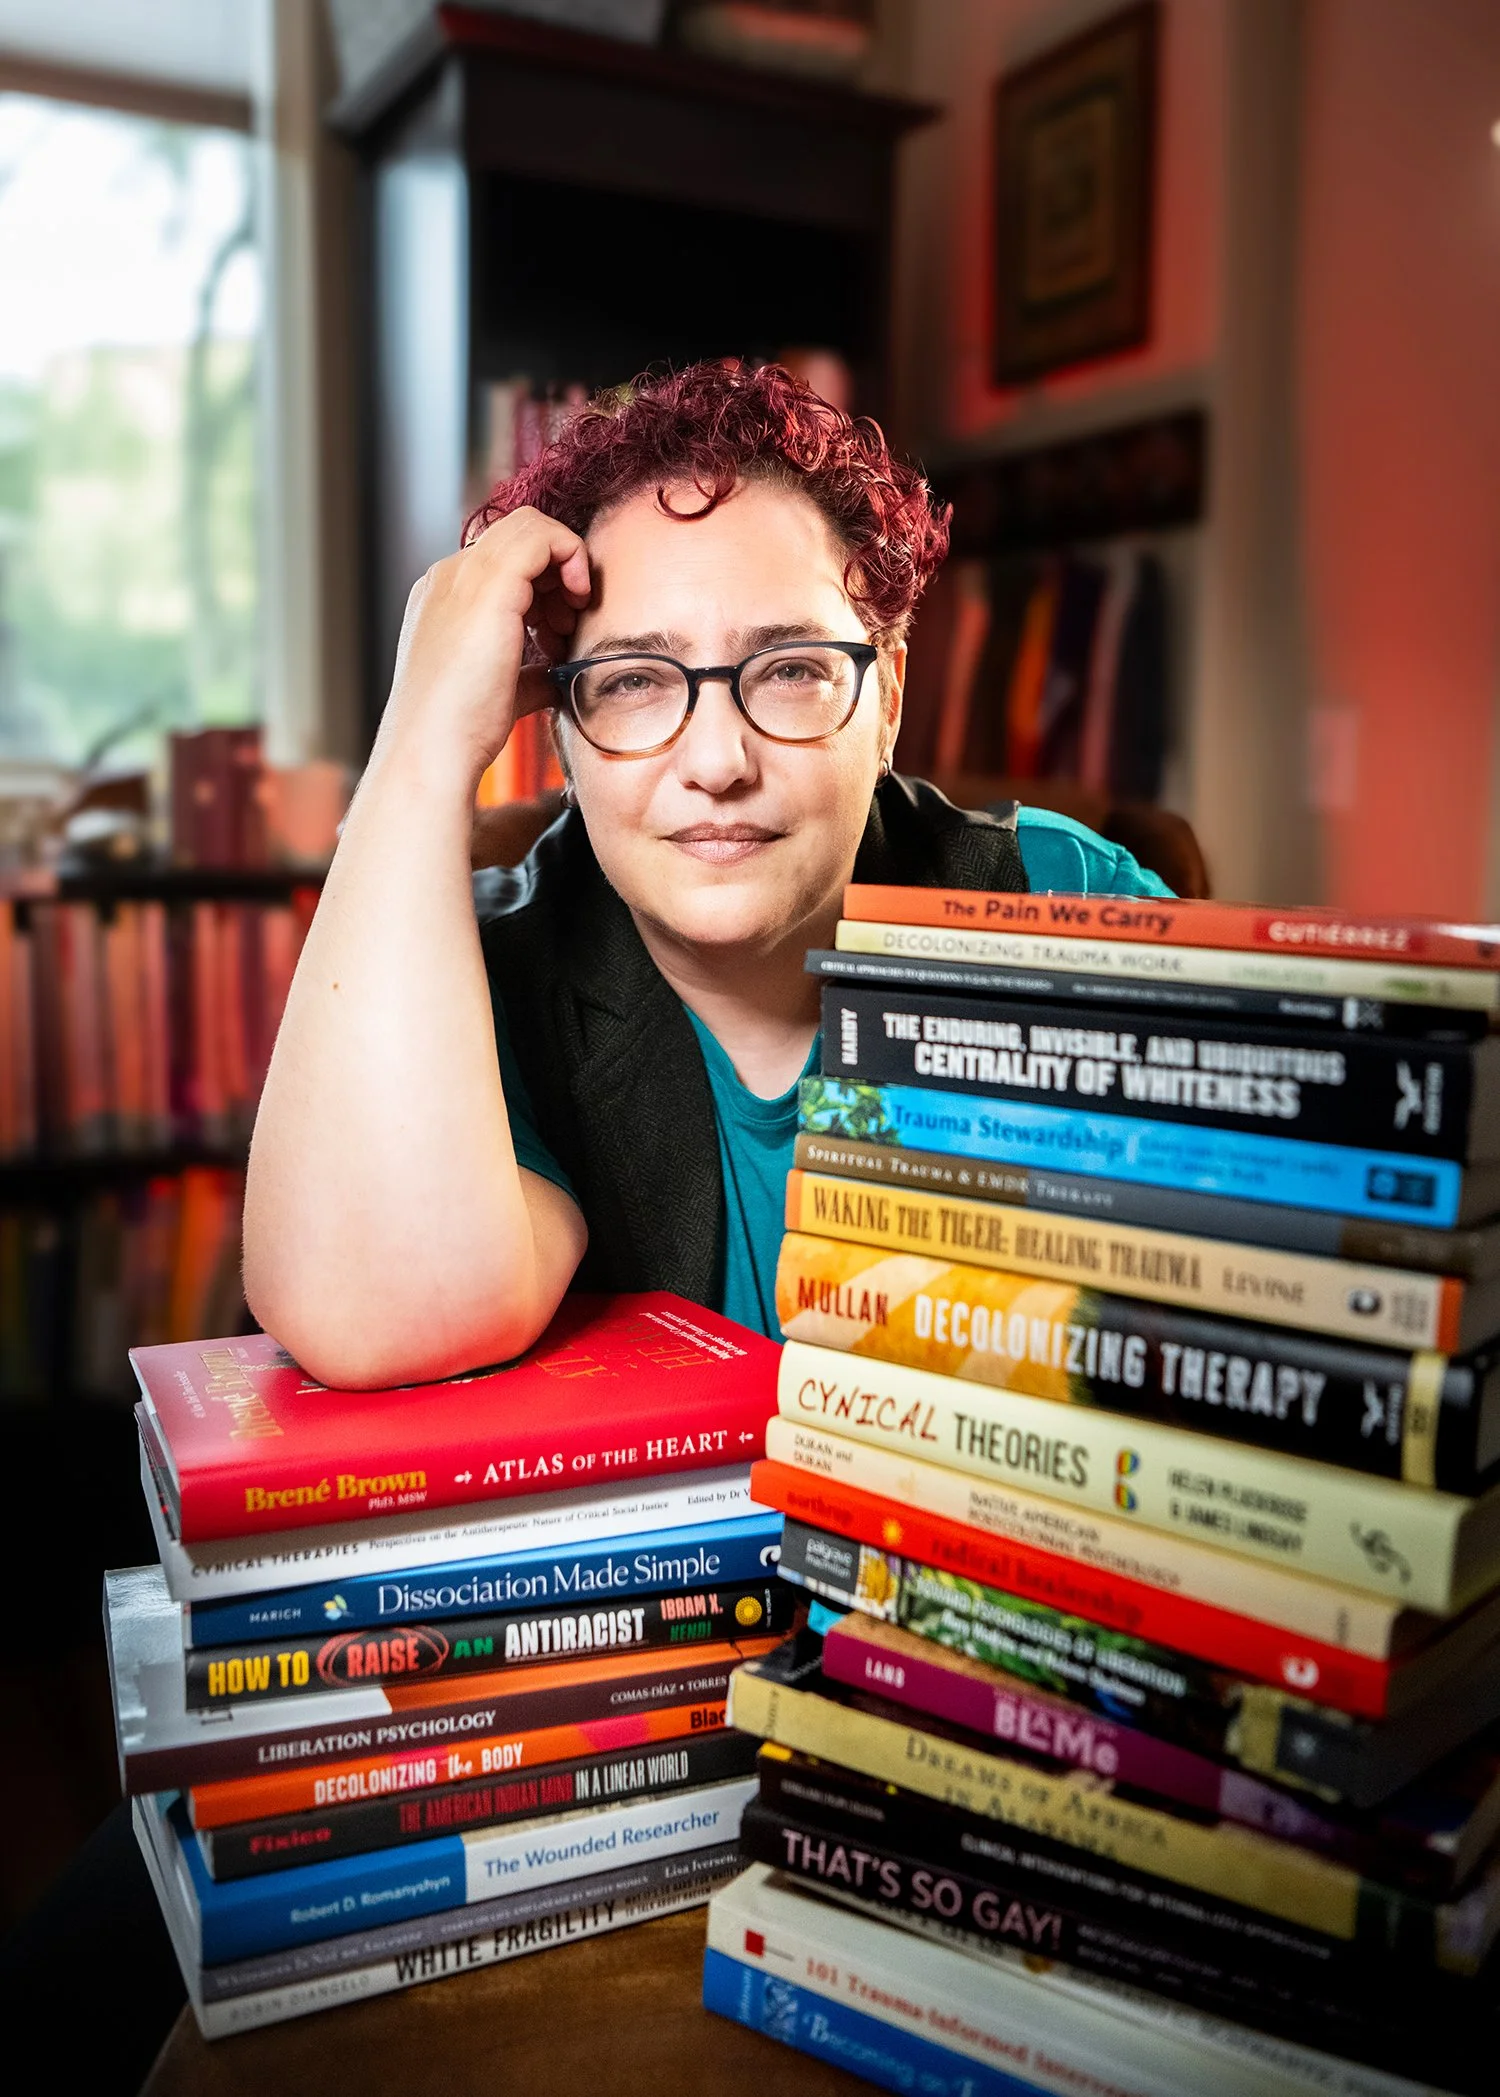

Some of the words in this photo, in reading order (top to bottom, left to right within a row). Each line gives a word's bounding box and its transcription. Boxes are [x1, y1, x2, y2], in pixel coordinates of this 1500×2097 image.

[943, 899, 975, 917] The
[984, 899, 1039, 920] Pain
[1050, 904, 1089, 925] We
[1099, 905, 1173, 934] Carry
[883, 931, 1024, 960] DECOLONIZING
[1032, 944, 1113, 967] TRAUMA
[1120, 950, 1183, 973] WORK
[882, 1012, 920, 1041] THE
[923, 1016, 1028, 1053] ENDURING,
[1029, 1025, 1142, 1063] INVISIBLE,
[1145, 1035, 1194, 1068] AND
[1196, 1039, 1346, 1086] UBIQUITOUS
[915, 1041, 1072, 1091] CENTRALITY
[1075, 1058, 1116, 1096] OF
[1121, 1063, 1301, 1119] WHITENESS
[893, 1104, 971, 1136] Trauma
[978, 1114, 1122, 1160] Stewardship
[957, 1171, 972, 1185] &
[813, 1186, 890, 1234] WAKING
[897, 1205, 933, 1240] THE
[938, 1206, 1009, 1254] TIGER:
[1014, 1223, 1103, 1271] HEALING
[1108, 1241, 1202, 1290] TRAUMA
[797, 1275, 889, 1325] MULLAN
[914, 1293, 1148, 1389] DECOLONIZING
[1158, 1338, 1327, 1428] THERAPY
[482, 1452, 564, 1484] ATLAS
[571, 1453, 597, 1471] OF
[601, 1447, 638, 1467] THE
[645, 1430, 728, 1461] HEART
[793, 1434, 833, 1457] DURAN
[835, 1448, 854, 1463] and
[793, 1450, 833, 1473] DURAN
[797, 1378, 939, 1443] CYNICAL
[952, 1409, 1091, 1488] THEORIES
[244, 1476, 332, 1513] Brené
[336, 1469, 427, 1501] Brown
[397, 1490, 428, 1507] MSW
[191, 1558, 264, 1578] CYNICAL
[271, 1542, 360, 1567] THERAPIES
[368, 1534, 427, 1551] Perspectives
[429, 1532, 442, 1543] on
[444, 1529, 458, 1539] the
[532, 1515, 562, 1528] Nature
[564, 1512, 575, 1522] of
[576, 1506, 610, 1521] Critical
[612, 1503, 638, 1516] Social
[640, 1500, 669, 1513] Justice
[687, 1492, 714, 1505] Edited
[716, 1491, 727, 1503] by
[729, 1489, 741, 1499] Dr
[806, 1537, 854, 1568] palgrave
[248, 1607, 302, 1624] MARICH
[377, 1572, 548, 1616] Dissociation
[553, 1558, 629, 1594] Made
[634, 1546, 721, 1585] Simple
[660, 1594, 707, 1621] IBRAM
[708, 1593, 724, 1615] X.
[207, 1654, 271, 1696] HOW
[277, 1650, 310, 1687] TO
[347, 1637, 420, 1677] RAISE
[453, 1636, 494, 1660] AN
[504, 1607, 646, 1659] ANTIRACIST
[669, 1620, 712, 1642] KENDI
[941, 1608, 971, 1637] Mary
[257, 1731, 373, 1764] LIBERATION
[376, 1709, 497, 1746] PSYCHOLOGY
[610, 1681, 677, 1704] COMAS-DÍAZ
[687, 1674, 728, 1692] TORRES
[314, 1758, 437, 1805] DECOLONIZING
[447, 1752, 474, 1780] the
[480, 1742, 524, 1773] BODY
[905, 1732, 1014, 1790] DREAMS
[399, 1801, 421, 1833] THE
[425, 1788, 493, 1827] AMERICAN
[495, 1780, 538, 1811] INDIAN
[539, 1772, 574, 1803] MIND
[575, 1770, 590, 1800] IN
[591, 1767, 602, 1797] A
[603, 1757, 646, 1795] LINEAR
[647, 1750, 689, 1785] WORLD
[290, 1900, 340, 1924] Robert
[360, 1875, 451, 1907] Romanyshyn
[484, 1855, 520, 1879] The
[524, 1831, 617, 1868] Wounded
[621, 1808, 721, 1846] Researcher
[664, 1863, 690, 1880] Lisa
[782, 1827, 902, 1900] THAT'S
[910, 1869, 964, 1918] SO
[972, 1890, 1063, 1951] GAY!
[393, 1934, 483, 1984] WHITE
[492, 1898, 618, 1956] FRAGILITY
[806, 1956, 841, 1988] 101
[847, 1971, 924, 2020] Trauma
